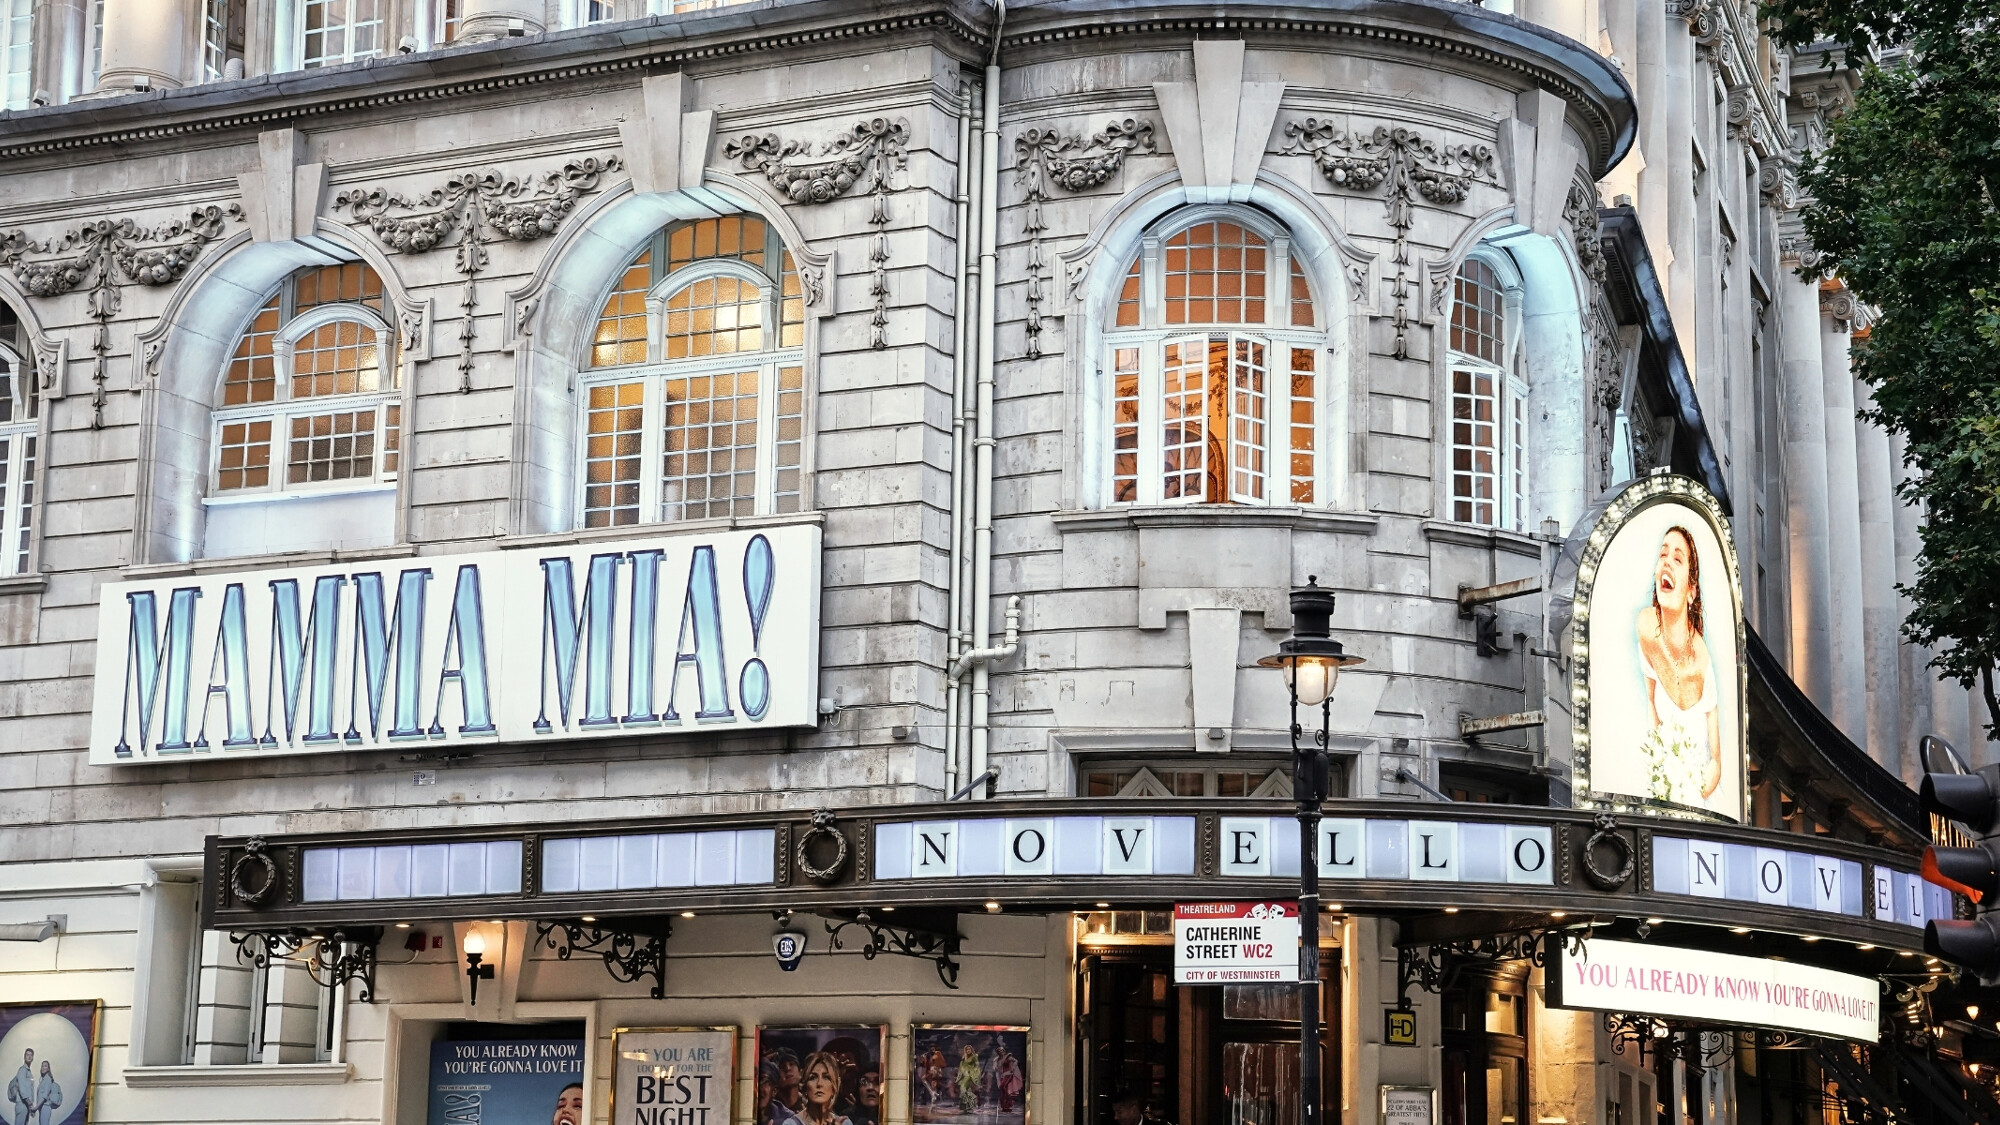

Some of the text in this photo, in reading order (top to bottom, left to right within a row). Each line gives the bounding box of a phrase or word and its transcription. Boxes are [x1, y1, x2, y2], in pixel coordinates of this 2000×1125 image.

[114, 533, 776, 757] MAMMA MIA!
[1179, 904, 1236, 914] THEATRELAND
[1186, 926, 1261, 941] CATHERINE
[780, 940, 793, 952] ECS
[1186, 944, 1273, 959] STREET WC2
[1186, 970, 1281, 980] CITY OF WESTMINSTER
[1575, 962, 1876, 1023] YOU ALREADY KNOW YOU'RE GONNA LOVE IT!
[455, 1044, 578, 1058] YOU ALREADY KNOW
[653, 1048, 683, 1062] YOU
[687, 1047, 714, 1061] ARE
[444, 1059, 583, 1074] YOU'RE GONNA LOVE IT
[676, 1064, 693, 1073] FOR
[696, 1063, 712, 1072] THE
[636, 1075, 713, 1105] BEST
[635, 1107, 711, 1125] NIGHT
